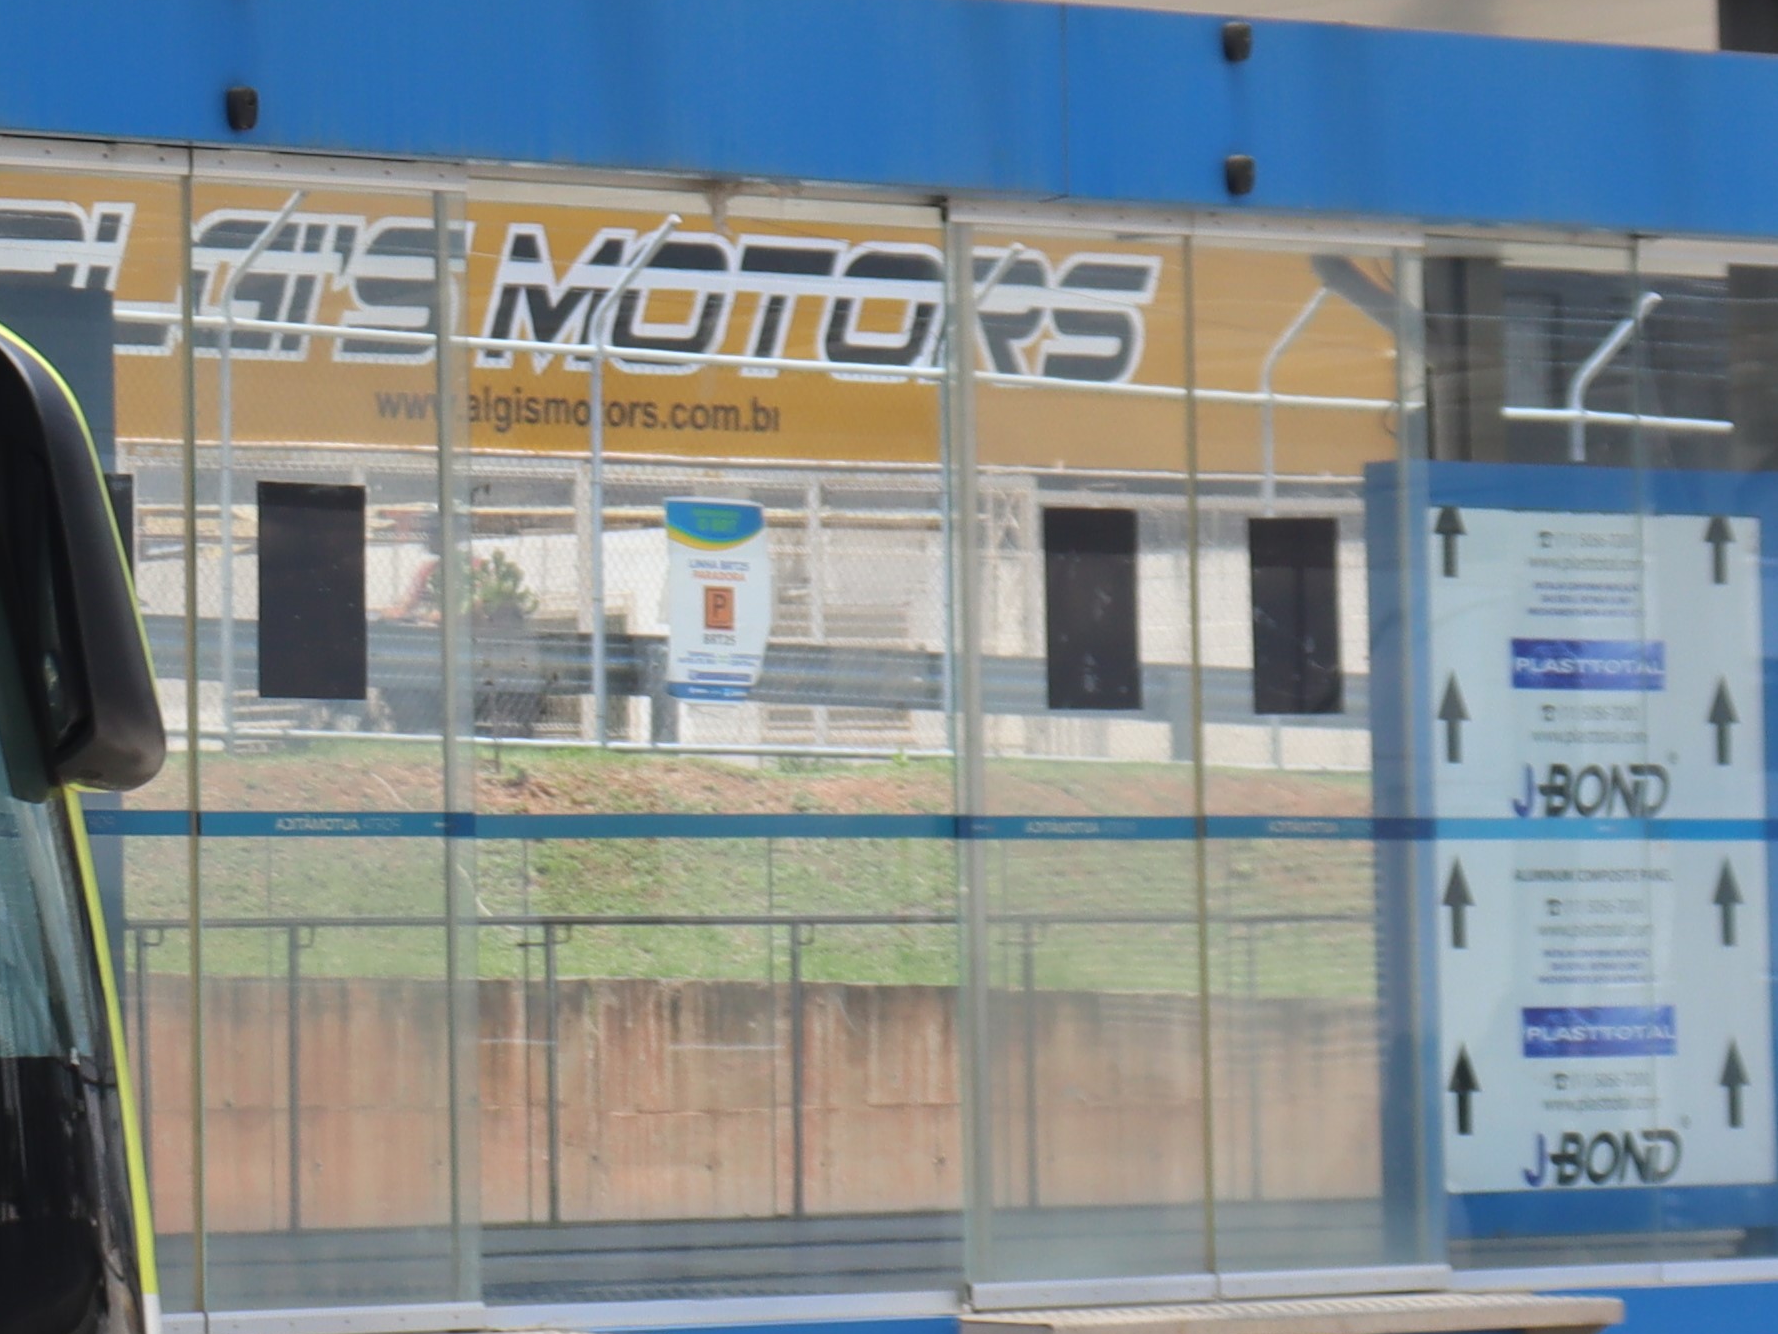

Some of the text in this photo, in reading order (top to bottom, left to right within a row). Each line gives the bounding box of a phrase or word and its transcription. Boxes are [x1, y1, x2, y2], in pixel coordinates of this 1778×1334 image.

[475, 222, 1161, 386] MOTORS
[714, 593, 727, 618] P
[1516, 657, 1665, 675] PLASTTOTAL
[1512, 763, 1671, 818] J-BOND
[1526, 1025, 1677, 1042] PLASTTOTAL
[1523, 1129, 1683, 1188] J-BOND
